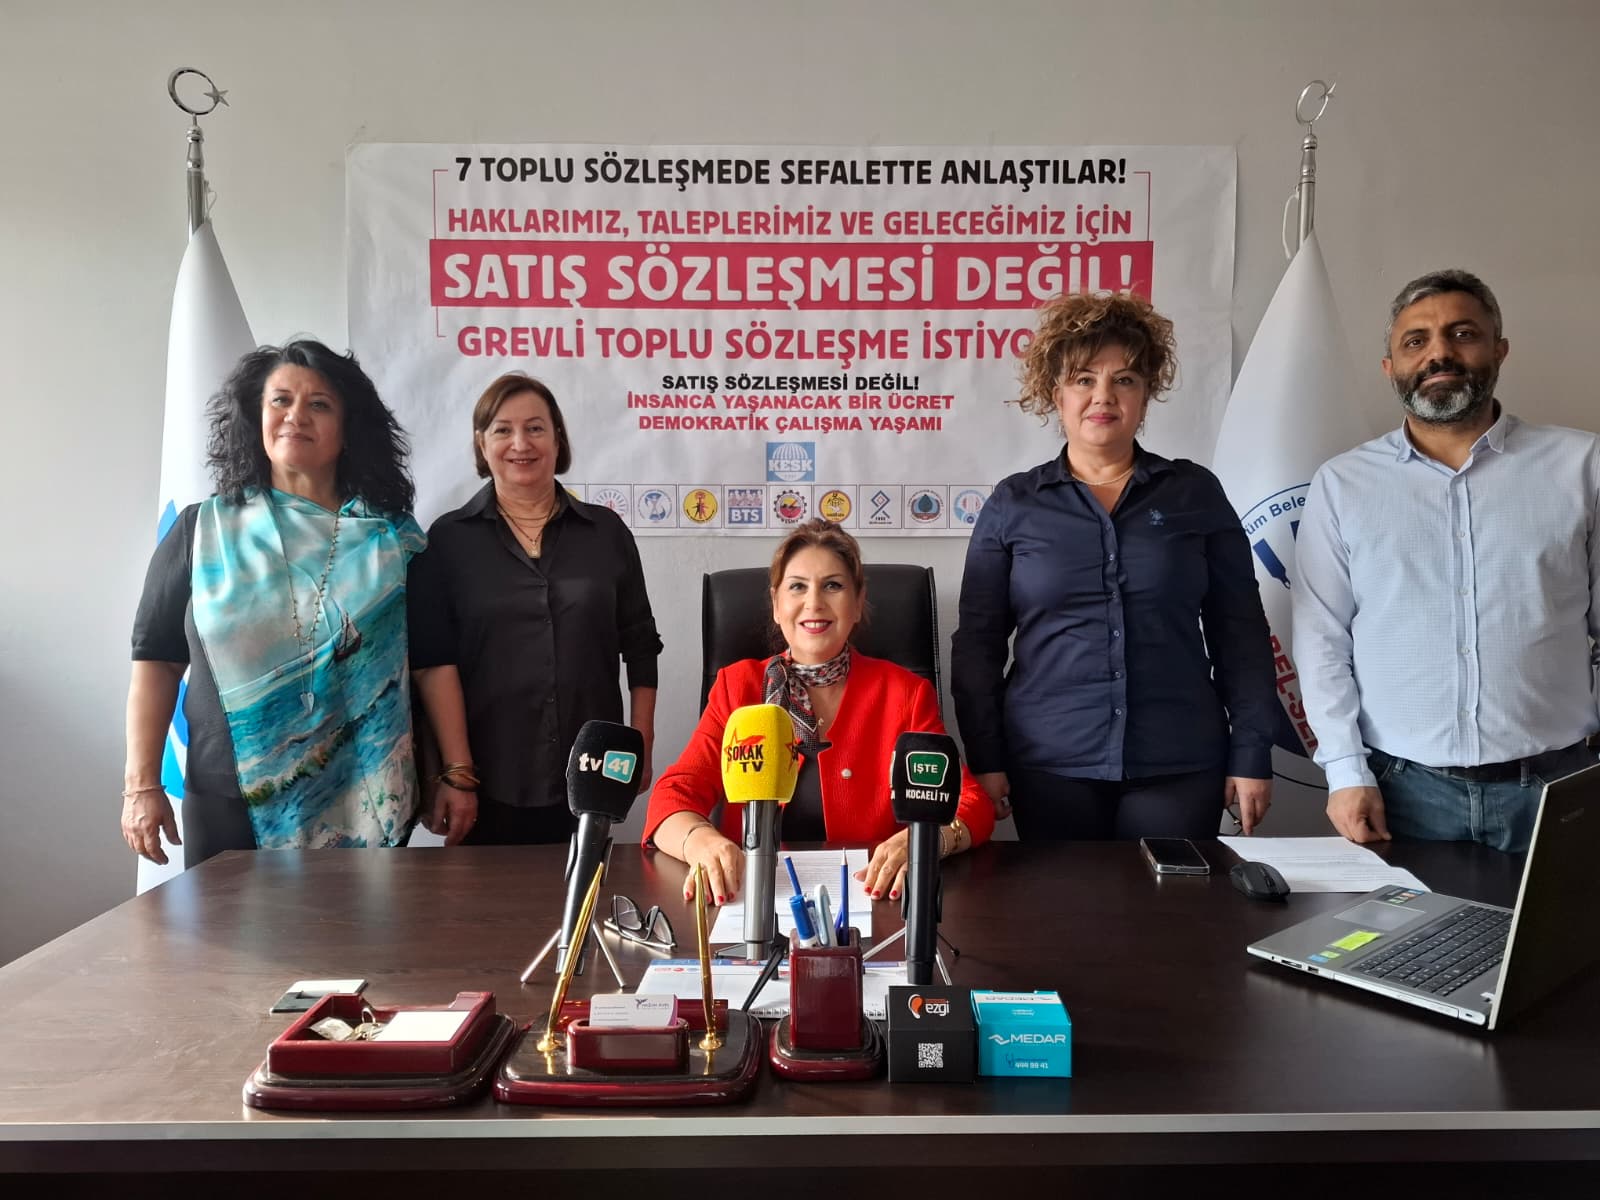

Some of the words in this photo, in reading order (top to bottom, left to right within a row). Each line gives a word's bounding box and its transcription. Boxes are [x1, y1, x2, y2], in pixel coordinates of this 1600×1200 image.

[455, 157, 471, 182] 7
[480, 157, 574, 183] TOPLU
[584, 151, 770, 192] SÖZLEŞMEDE
[780, 159, 932, 185] SEFALETTE
[941, 158, 1126, 192] ANLAŞTILAR!
[448, 208, 629, 237] HAKLARIMIZ,
[637, 205, 832, 236] TALEPLERİMİZ
[840, 211, 873, 236] VE
[883, 204, 1066, 236] GELECEĞİMİZ
[1075, 204, 1132, 242] İÇİN
[444, 254, 587, 308] SATIŞ
[608, 243, 934, 310] SÖZLEŞMESİ
[956, 244, 1133, 302] DEĞİL!
[457, 319, 585, 359] GREVLİ
[595, 327, 714, 361] TOPLU
[725, 320, 909, 371] SÖZLEŞME
[922, 320, 1036, 361] İSTİYO
[662, 375, 719, 394] SATIŞ
[724, 373, 848, 394] SÖZLEŞMESİ
[855, 372, 919, 391] DEĞİL!
[627, 391, 716, 410] İNSANCA
[723, 395, 842, 412] YAŞANACAK
[848, 391, 881, 411] BİR
[888, 391, 955, 411] ÜCRET
[639, 413, 769, 431] DEMOKRATİK
[775, 416, 863, 433] ÇALIŞMA
[869, 416, 942, 433] YAŞAMI
[768, 459, 813, 472] KESK
[731, 509, 760, 523] BTS
[1245, 515, 1268, 535] üm
[1269, 496, 1306, 517] Bele
[727, 744, 764, 761] SOKAK
[579, 753, 603, 772] tv
[608, 758, 630, 775] 41
[739, 761, 764, 773] TV
[905, 788, 938, 801] KOCAELİ
[939, 792, 950, 803] TV
[925, 1000, 950, 1017] ezgi
[1010, 1034, 1067, 1044] MEDAR
